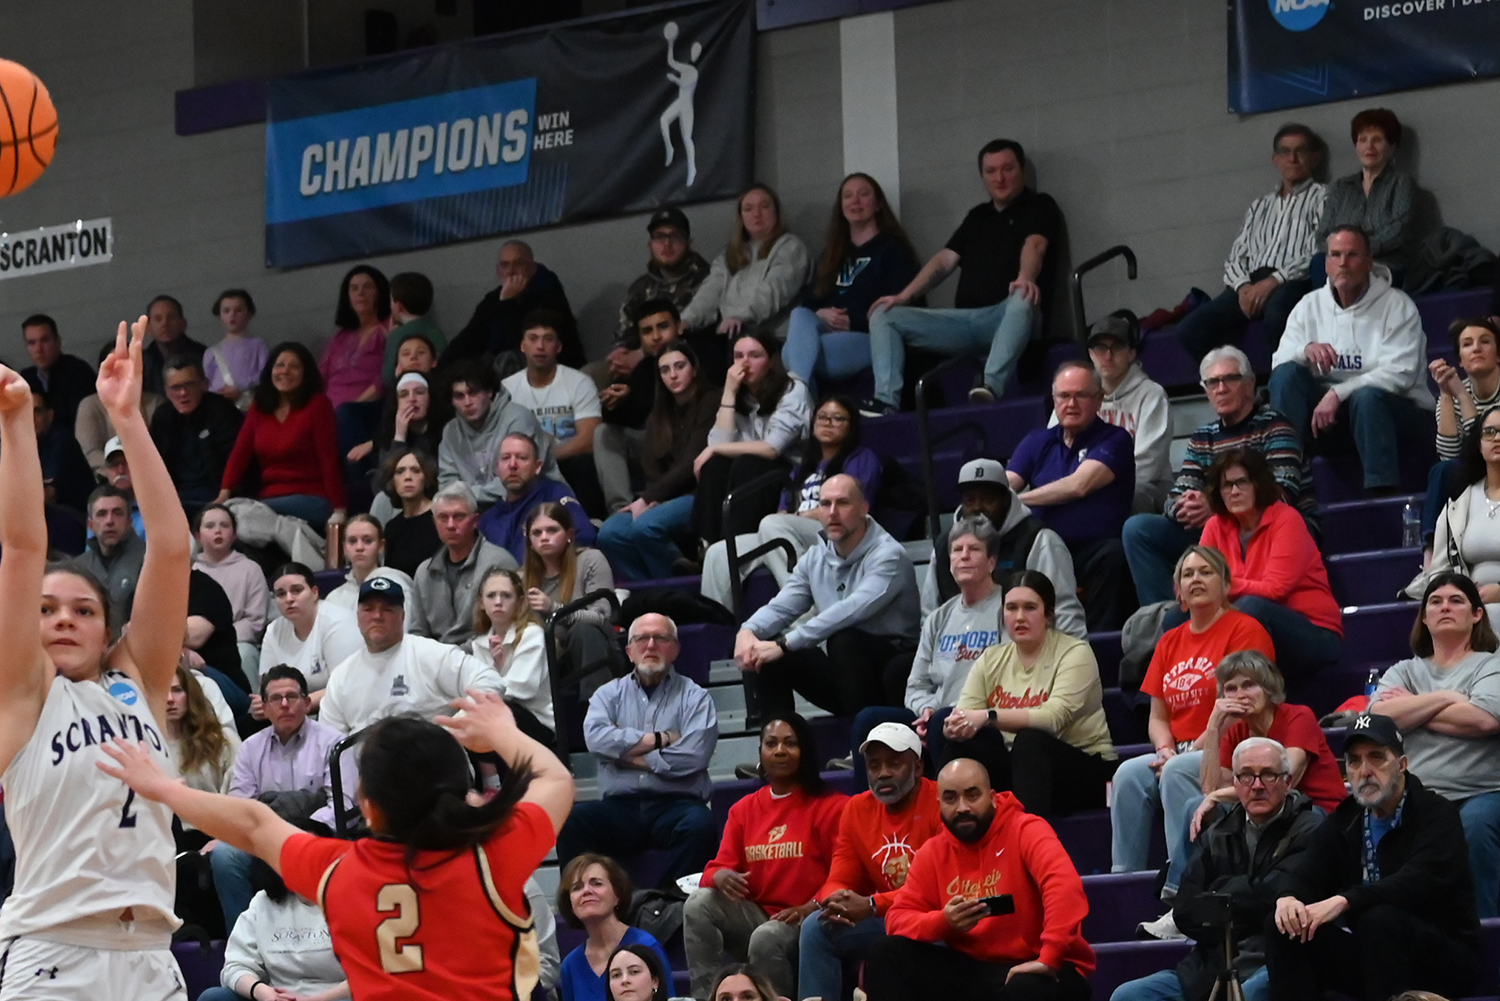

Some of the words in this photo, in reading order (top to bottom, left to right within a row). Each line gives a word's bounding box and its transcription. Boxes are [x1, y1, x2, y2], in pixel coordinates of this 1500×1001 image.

[1363, 0, 1445, 20] DISCOVER
[538, 111, 570, 130] WIN
[300, 109, 528, 196] CHAMPIONS
[533, 129, 574, 150] HERE
[0, 226, 108, 271] SCRANTON
[51, 713, 169, 766] SCRANTO
[745, 841, 804, 863] BASKETBALL
[376, 884, 424, 974] 2
